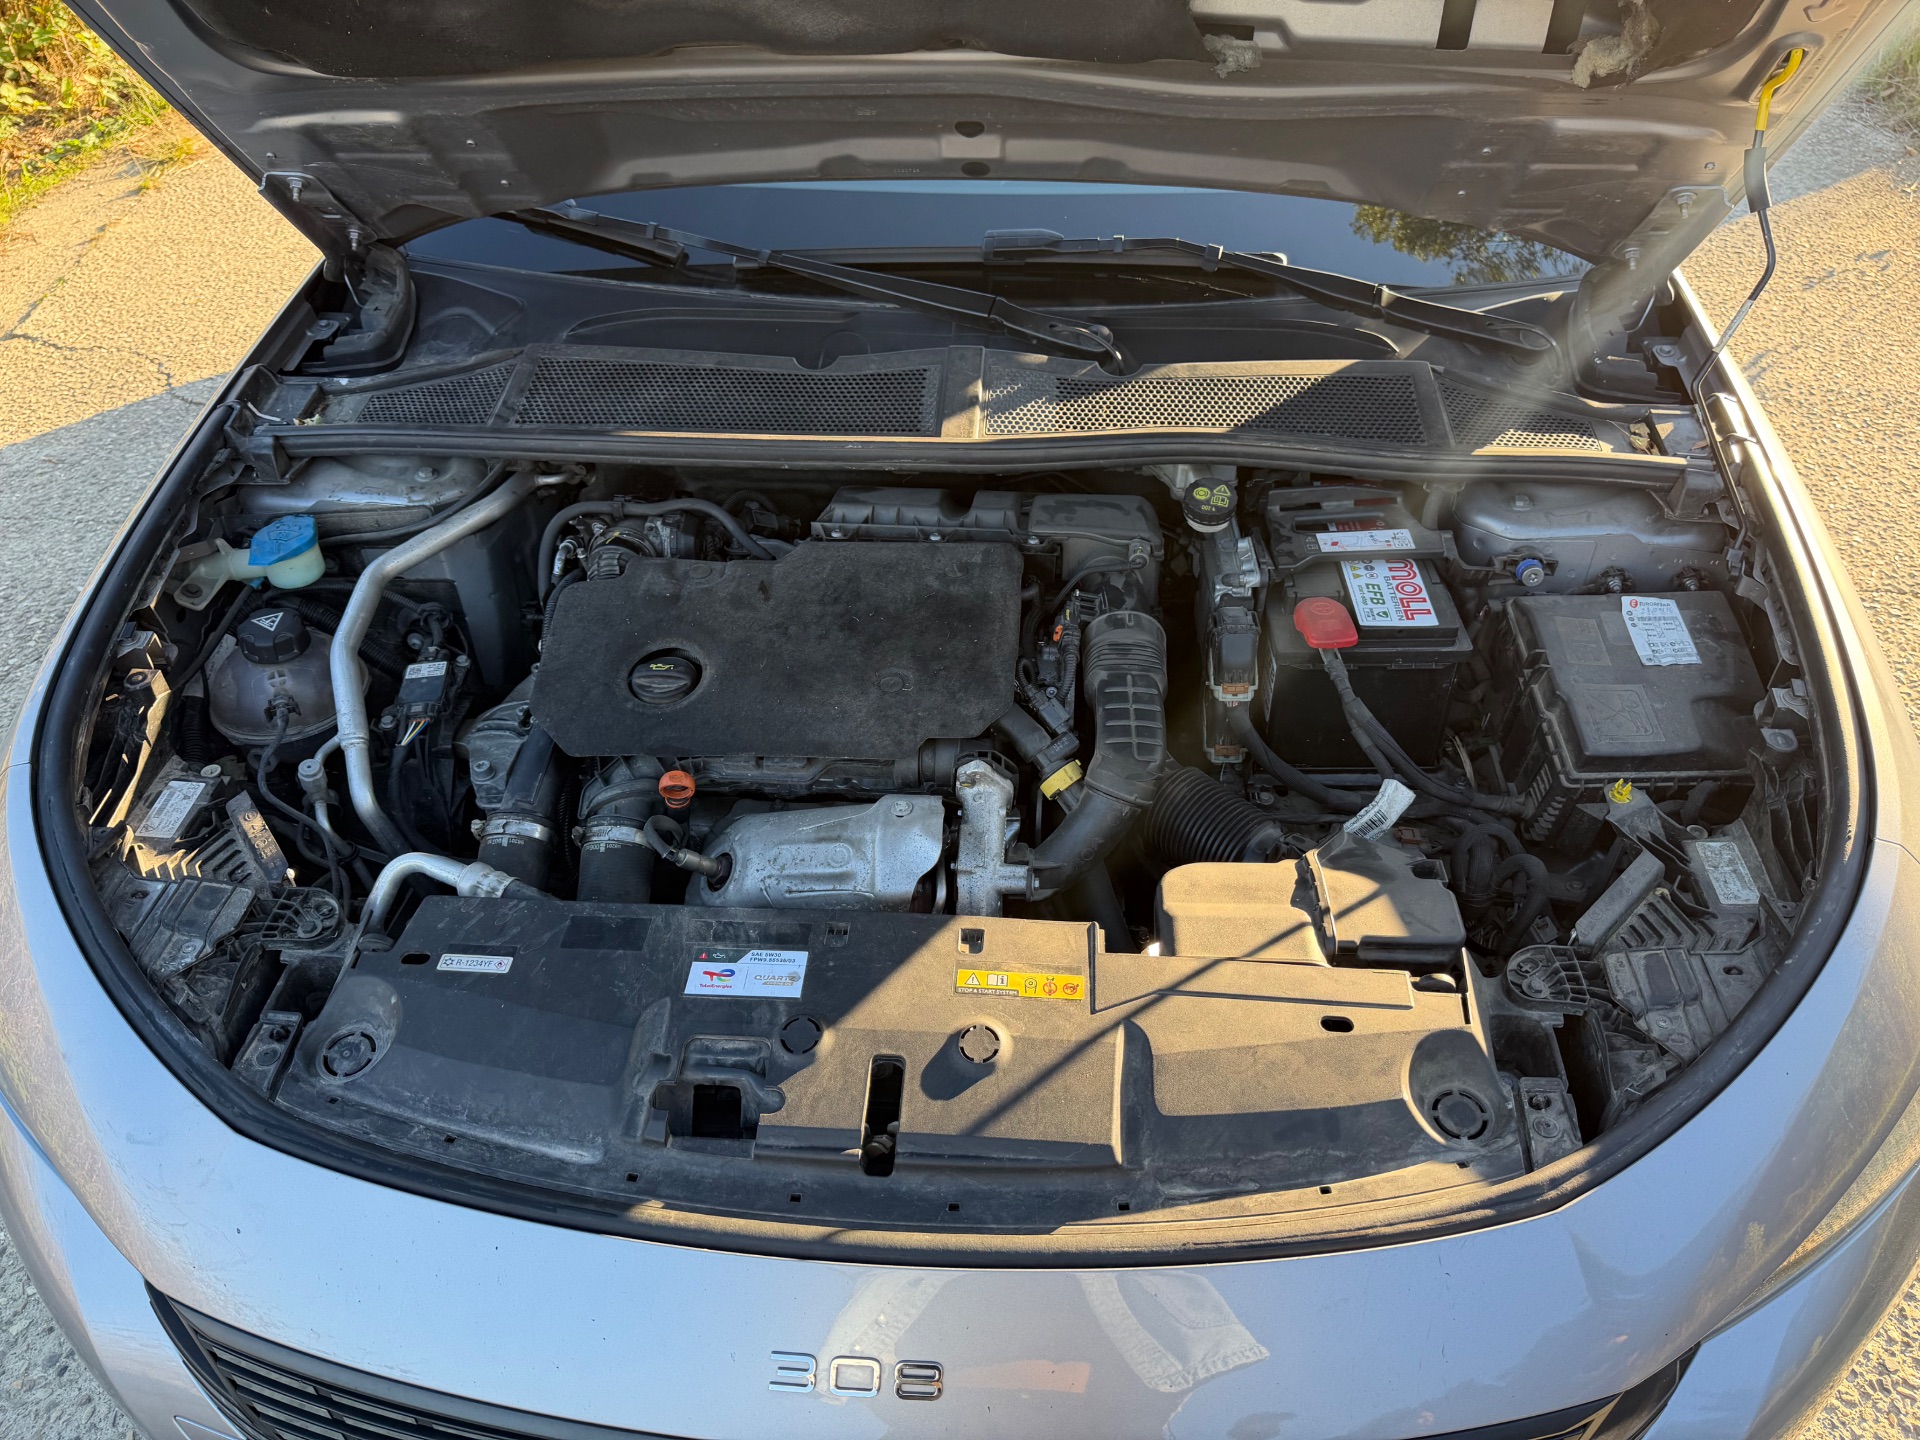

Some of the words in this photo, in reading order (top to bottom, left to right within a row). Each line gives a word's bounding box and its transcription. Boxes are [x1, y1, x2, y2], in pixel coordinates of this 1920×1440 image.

[1365, 582, 1387, 606] EFB
[1383, 576, 1406, 621] BATTERIEN
[455, 959, 494, 967] R-1234YF
[754, 974, 797, 982] QUARTZ
[768, 1350, 944, 1402] 308
